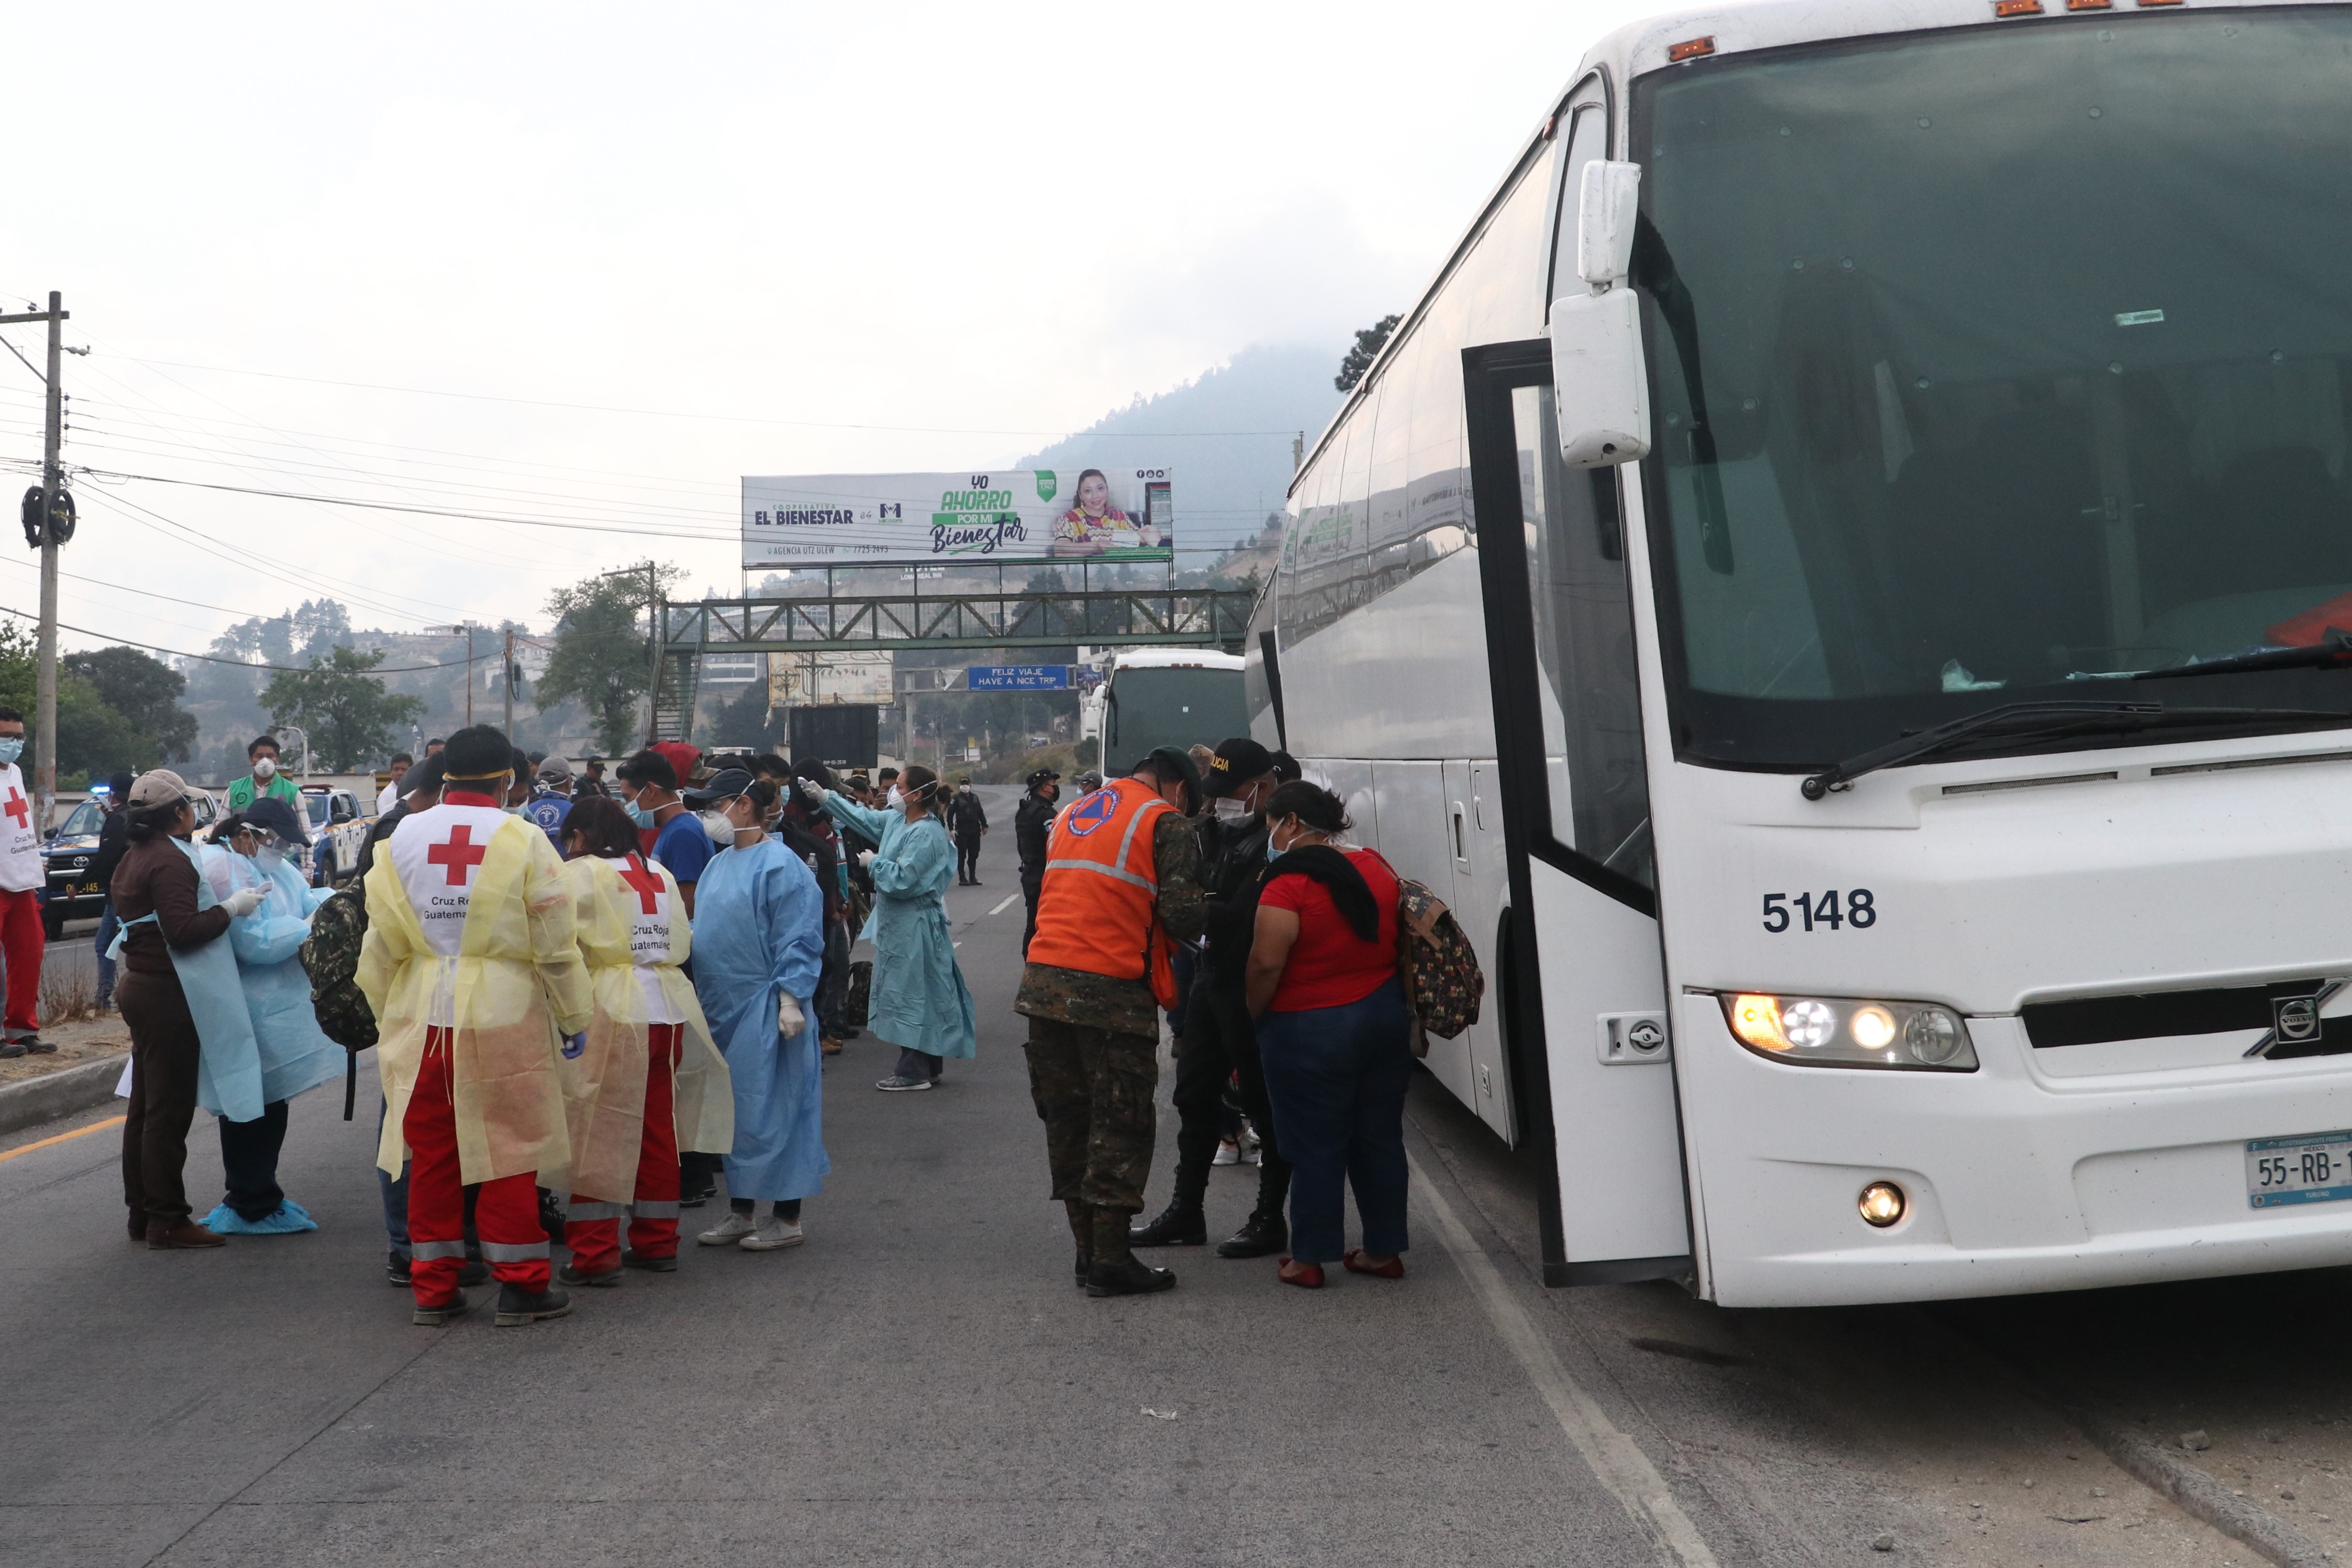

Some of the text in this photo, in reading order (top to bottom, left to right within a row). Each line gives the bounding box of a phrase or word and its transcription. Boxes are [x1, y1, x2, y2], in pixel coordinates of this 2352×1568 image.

[971, 475, 989, 489] YO
[941, 490, 1012, 511] AHORRO
[755, 510, 872, 525] EL BIENESTAR es
[957, 514, 993, 524] POR MI
[930, 513, 1028, 554] Bienestar
[773, 547, 801, 555] AGENCIA
[817, 546, 835, 554] ULEW
[431, 897, 455, 906] Cruz
[1763, 888, 1877, 934] 5148
[632, 925, 669, 937] Cruz Roja
[2279, 1137, 2325, 1147] AUTOTRANSPORTE
